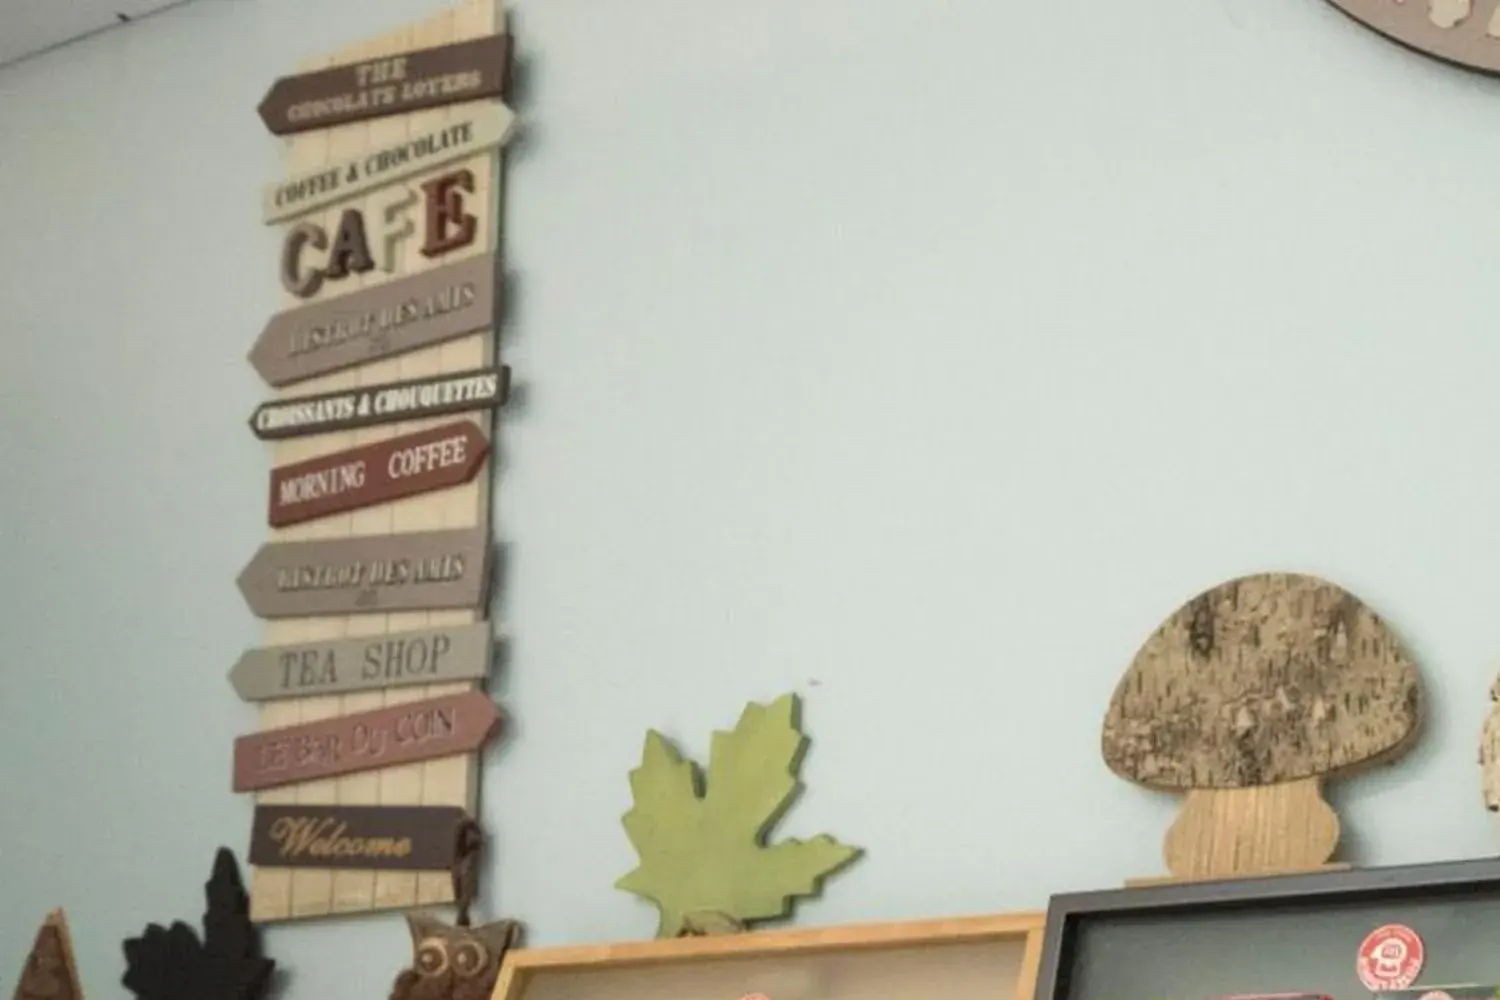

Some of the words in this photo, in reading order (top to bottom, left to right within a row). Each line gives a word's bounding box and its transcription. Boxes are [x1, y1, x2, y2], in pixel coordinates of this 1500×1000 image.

[286, 87, 397, 123] CHOCOLATE
[402, 69, 482, 102] LOVERS
[355, 58, 408, 86] THE
[274, 168, 342, 207] COFFEE
[345, 162, 359, 184] &
[364, 121, 474, 179] CHOCOLATE
[280, 167, 479, 300] CAFE
[278, 460, 367, 507] MORNING
[387, 435, 468, 480] COFFEE
[278, 648, 340, 690] TEA
[360, 631, 451, 682] SHOP
[268, 813, 414, 859] Welcome
